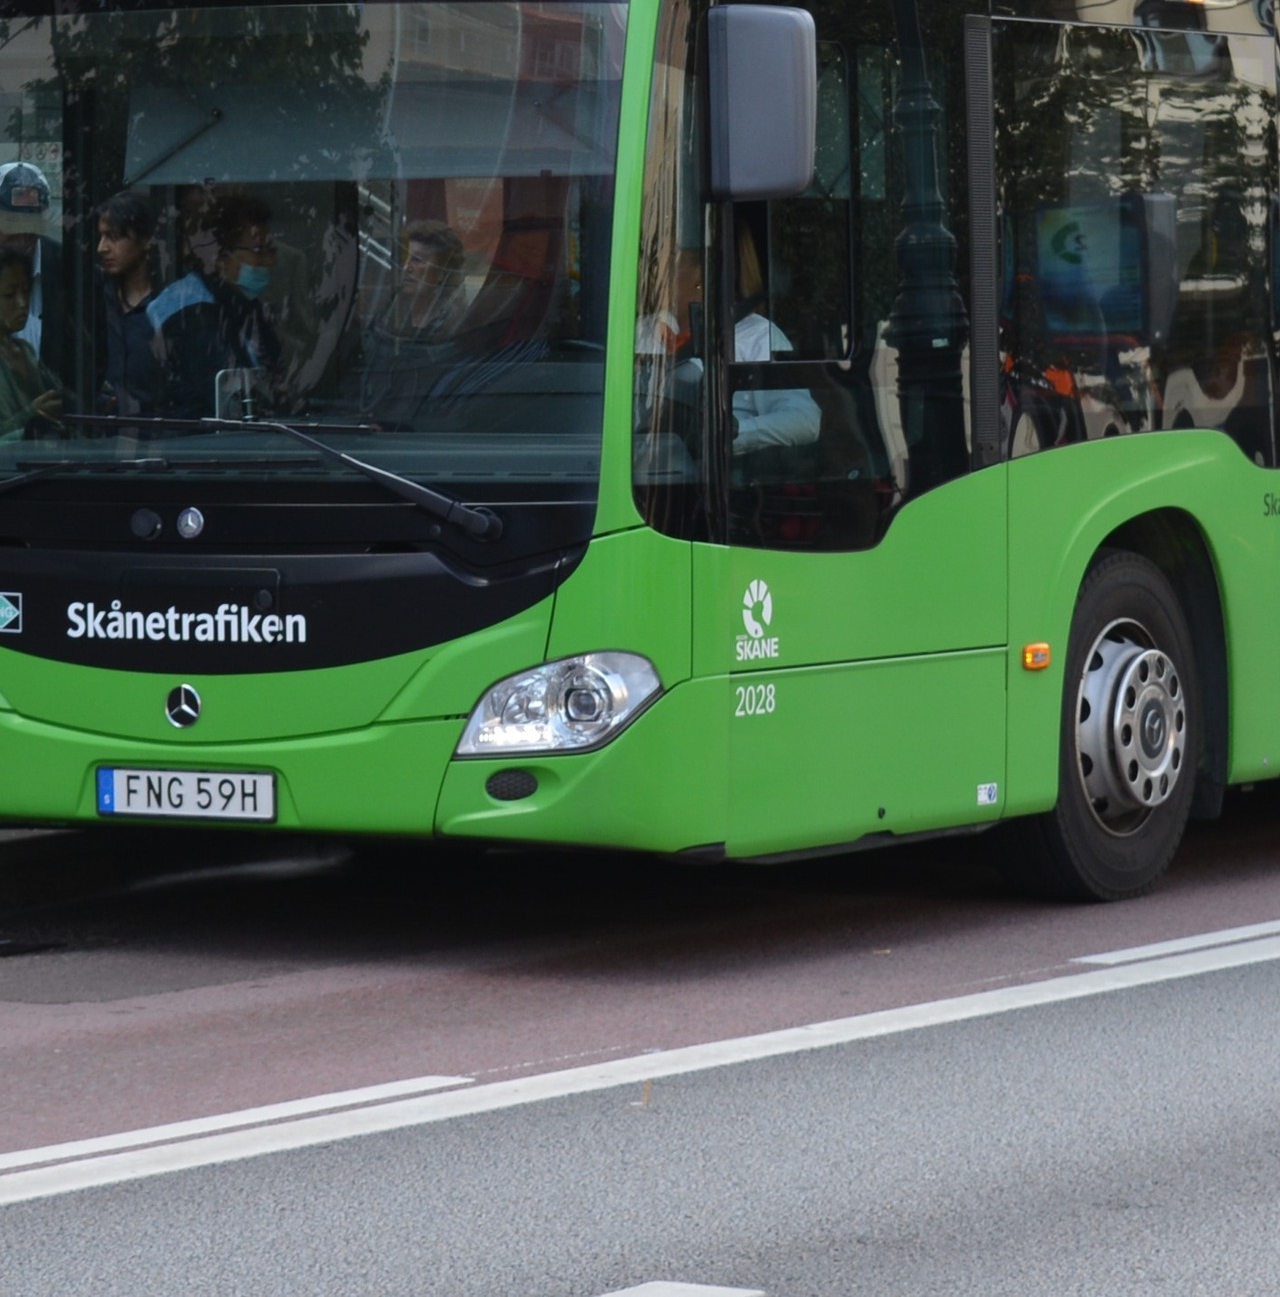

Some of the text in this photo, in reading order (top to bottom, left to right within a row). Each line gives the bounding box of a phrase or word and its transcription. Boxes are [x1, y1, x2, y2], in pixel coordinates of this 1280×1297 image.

[67, 600, 307, 643] Skånetrafiken
[735, 683, 776, 717] 2028
[126, 775, 258, 812] FNG 59H
